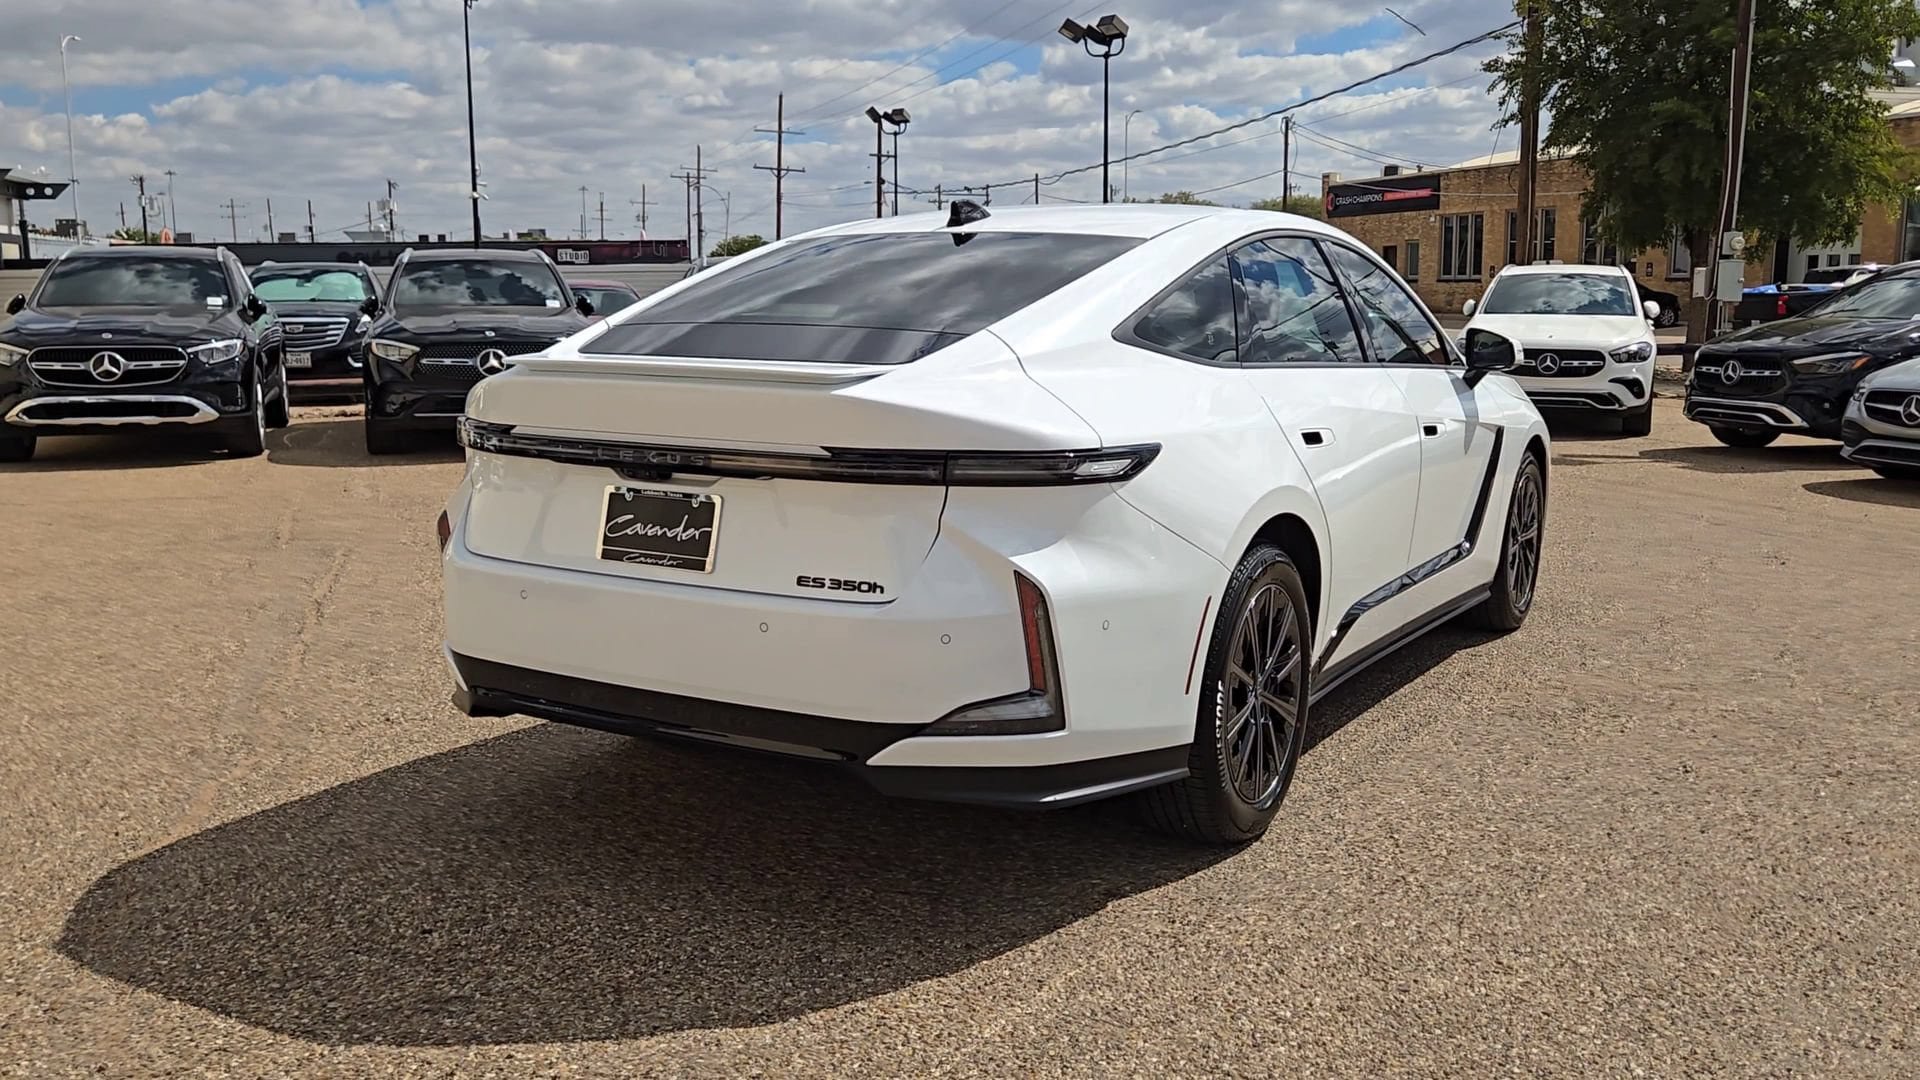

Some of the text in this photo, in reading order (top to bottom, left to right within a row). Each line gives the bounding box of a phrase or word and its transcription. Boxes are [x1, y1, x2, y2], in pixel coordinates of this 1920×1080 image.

[1335, 195, 1353, 206] CRASH
[559, 250, 589, 261] STUDIO
[597, 446, 706, 466] LEXUS
[605, 514, 712, 541] Cavender
[623, 553, 683, 566] Cavender
[796, 575, 885, 594] ES 350h
